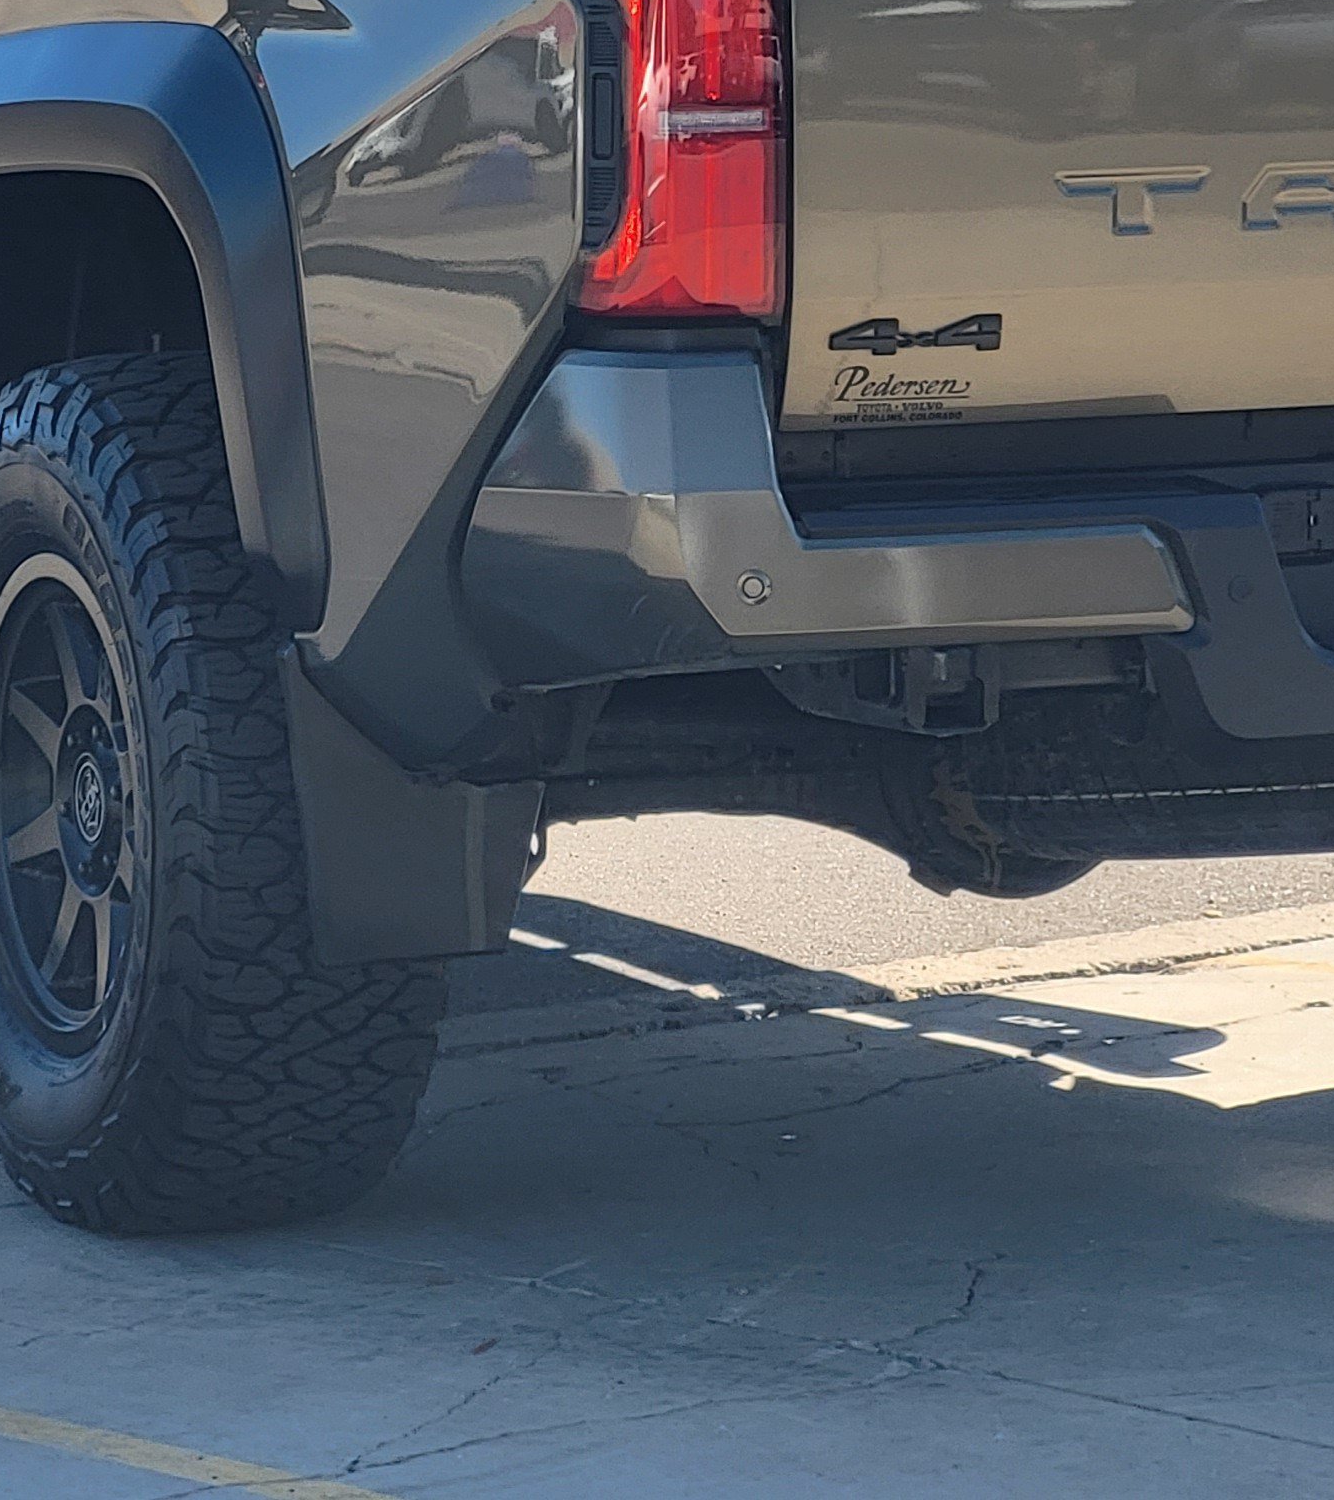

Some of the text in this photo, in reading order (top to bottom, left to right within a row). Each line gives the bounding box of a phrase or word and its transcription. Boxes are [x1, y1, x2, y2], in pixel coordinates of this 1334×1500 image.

[834, 366, 970, 402] Pedersen
[856, 401, 943, 413] TOYOTA VOLVO
[833, 414, 858, 424] FORT
[909, 411, 963, 421] COLORADO
